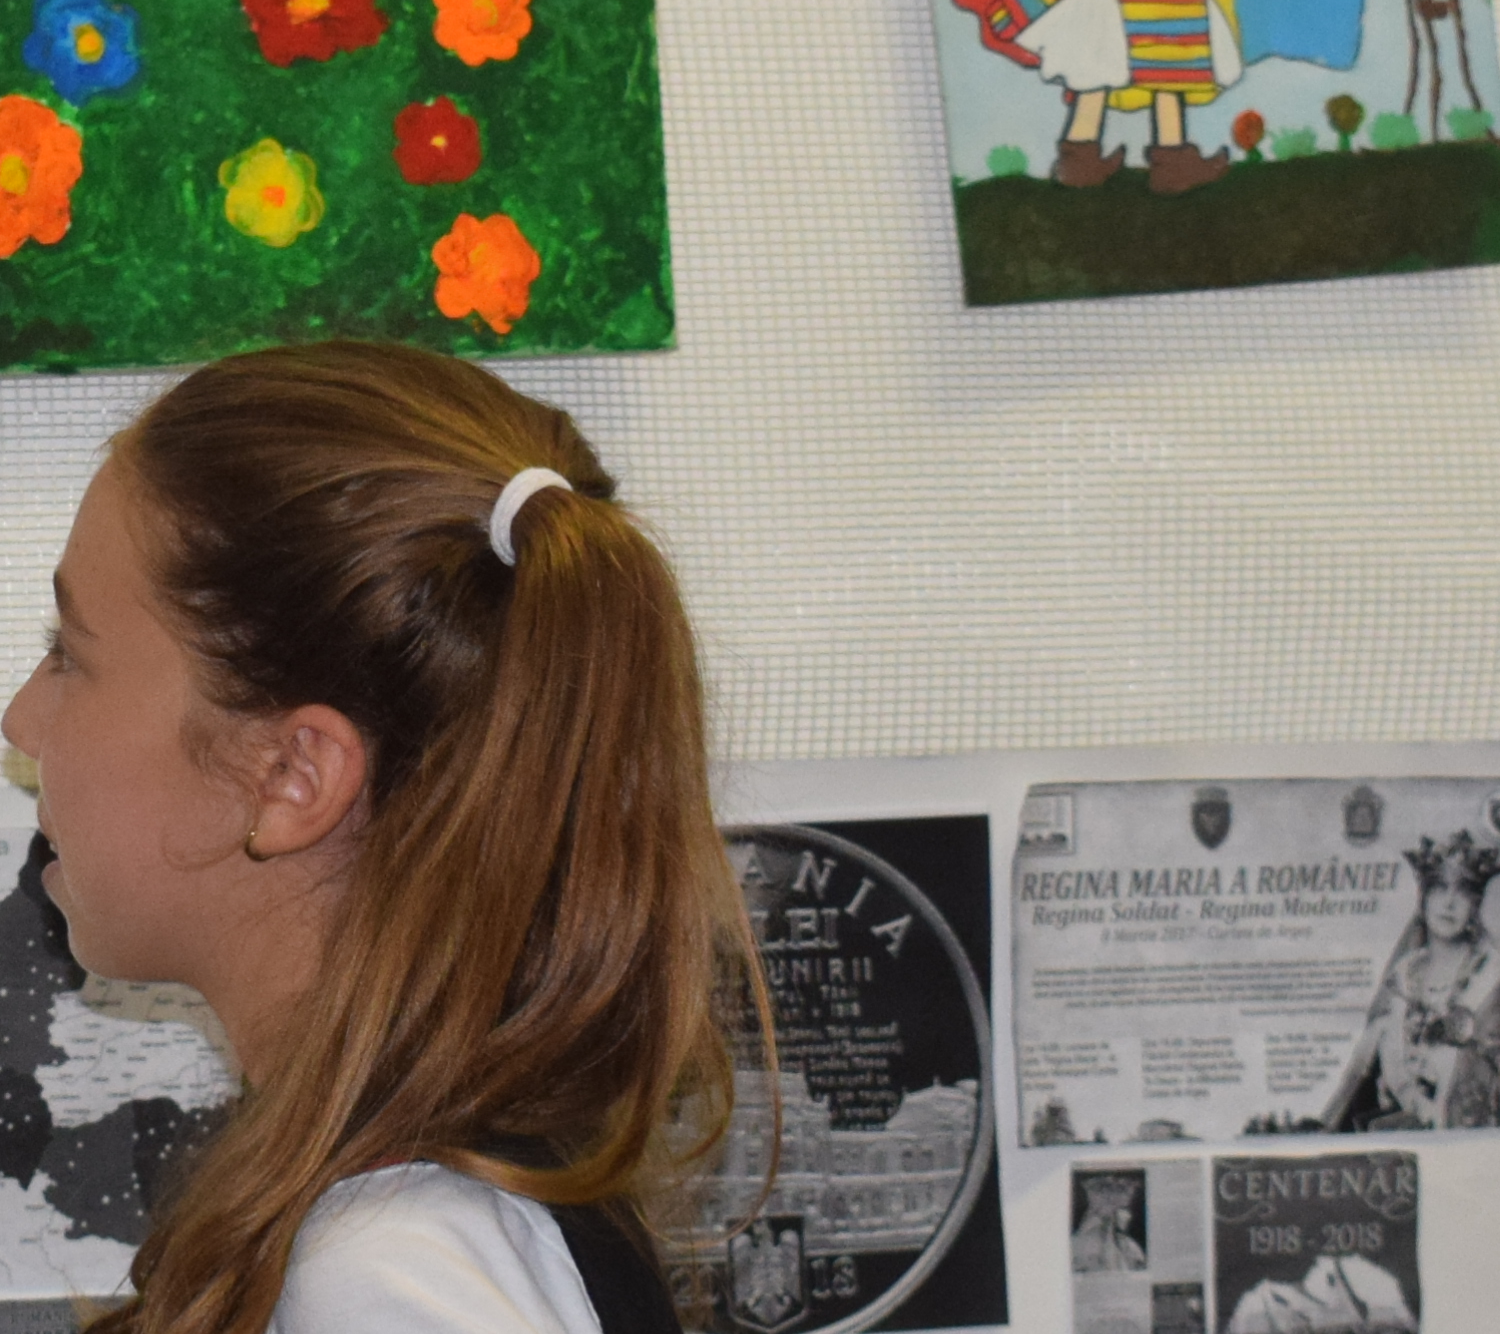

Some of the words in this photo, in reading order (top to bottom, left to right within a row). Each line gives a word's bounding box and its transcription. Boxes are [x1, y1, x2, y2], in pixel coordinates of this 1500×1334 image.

[1021, 870, 1118, 902] REGINA
[1127, 866, 1222, 898] MARIA
[1230, 868, 1248, 895] A
[1256, 856, 1400, 895] ROMÂNIEI
[1032, 903, 1105, 929] Regina
[1110, 900, 1179, 922] Soldat
[1200, 899, 1275, 928] Regina
[1219, 1167, 1416, 1201] CENTENAR
[1321, 1222, 1384, 1253] 2018
